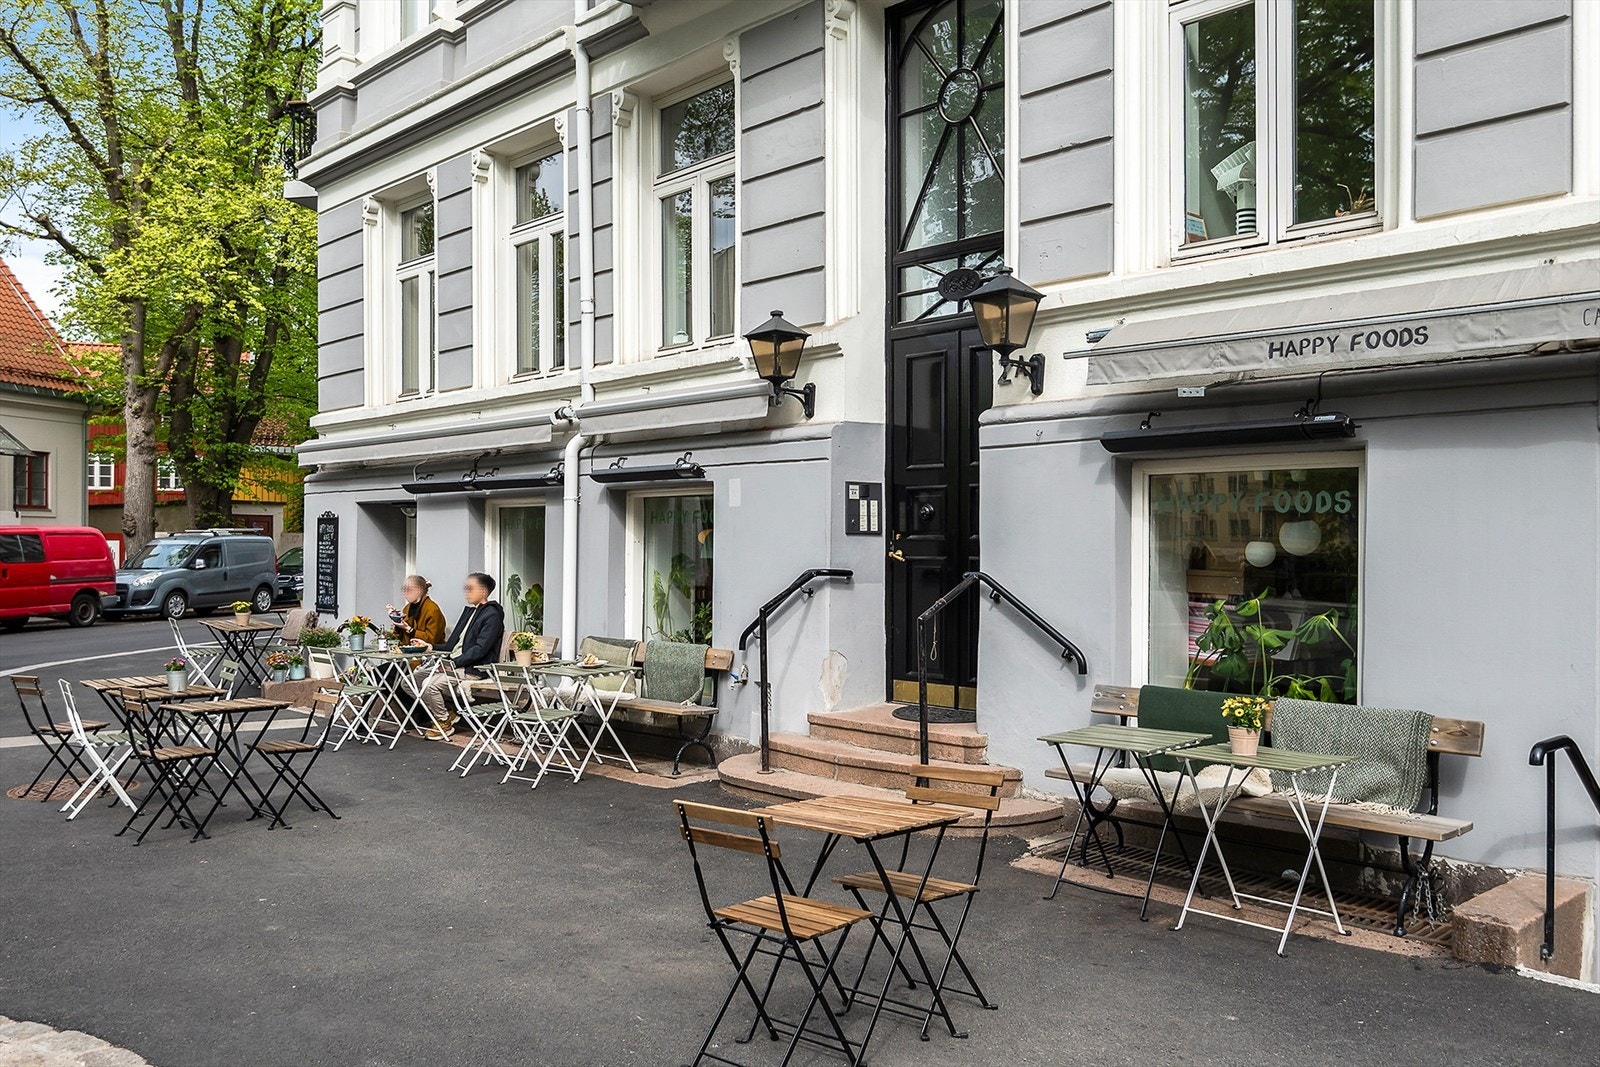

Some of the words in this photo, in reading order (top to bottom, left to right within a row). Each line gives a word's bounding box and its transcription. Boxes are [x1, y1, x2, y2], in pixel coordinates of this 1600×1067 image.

[1268, 335, 1339, 360] HAPPY
[1350, 325, 1429, 352] FOODS
[1158, 491, 1245, 514] HAPPY
[1255, 490, 1351, 514] FOODS
[650, 510, 688, 525] HAPY
